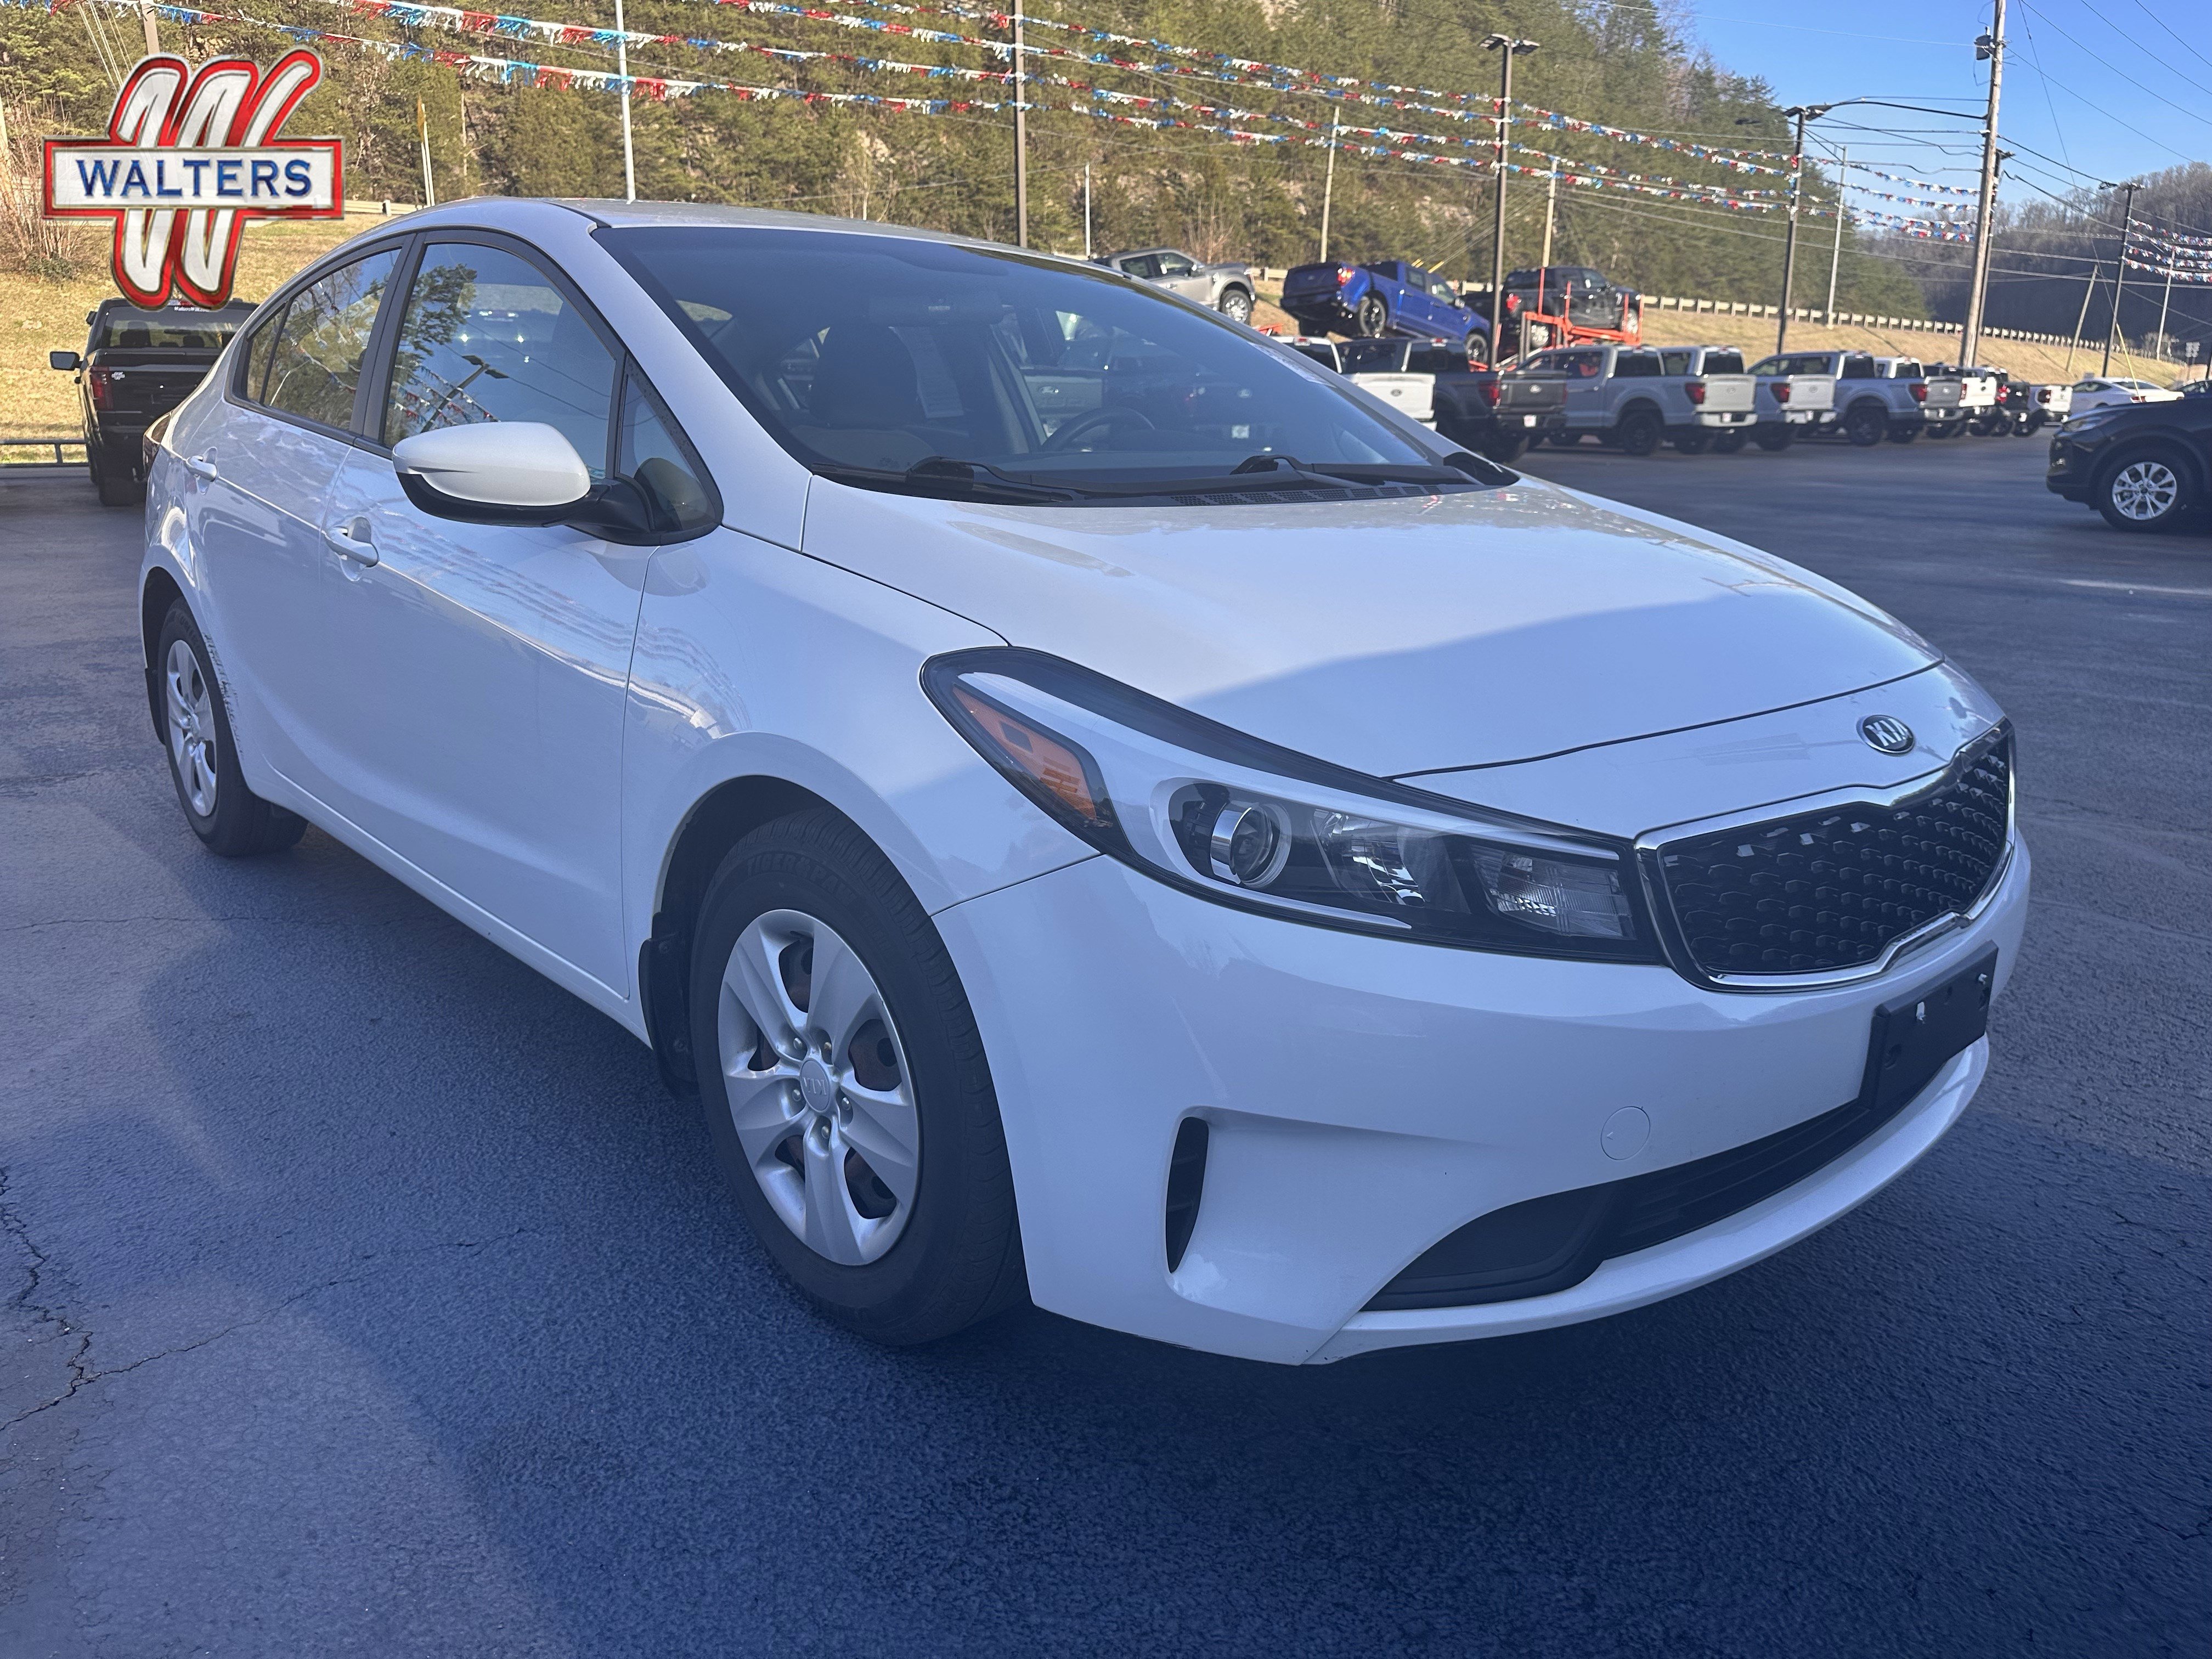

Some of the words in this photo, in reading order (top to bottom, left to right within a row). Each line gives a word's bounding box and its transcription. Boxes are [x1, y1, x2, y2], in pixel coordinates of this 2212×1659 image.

[1865, 718, 1910, 747] KIA
[747, 853, 797, 879] TIGER
[810, 865, 857, 905] PAW
[803, 1076, 827, 1096] KIA
